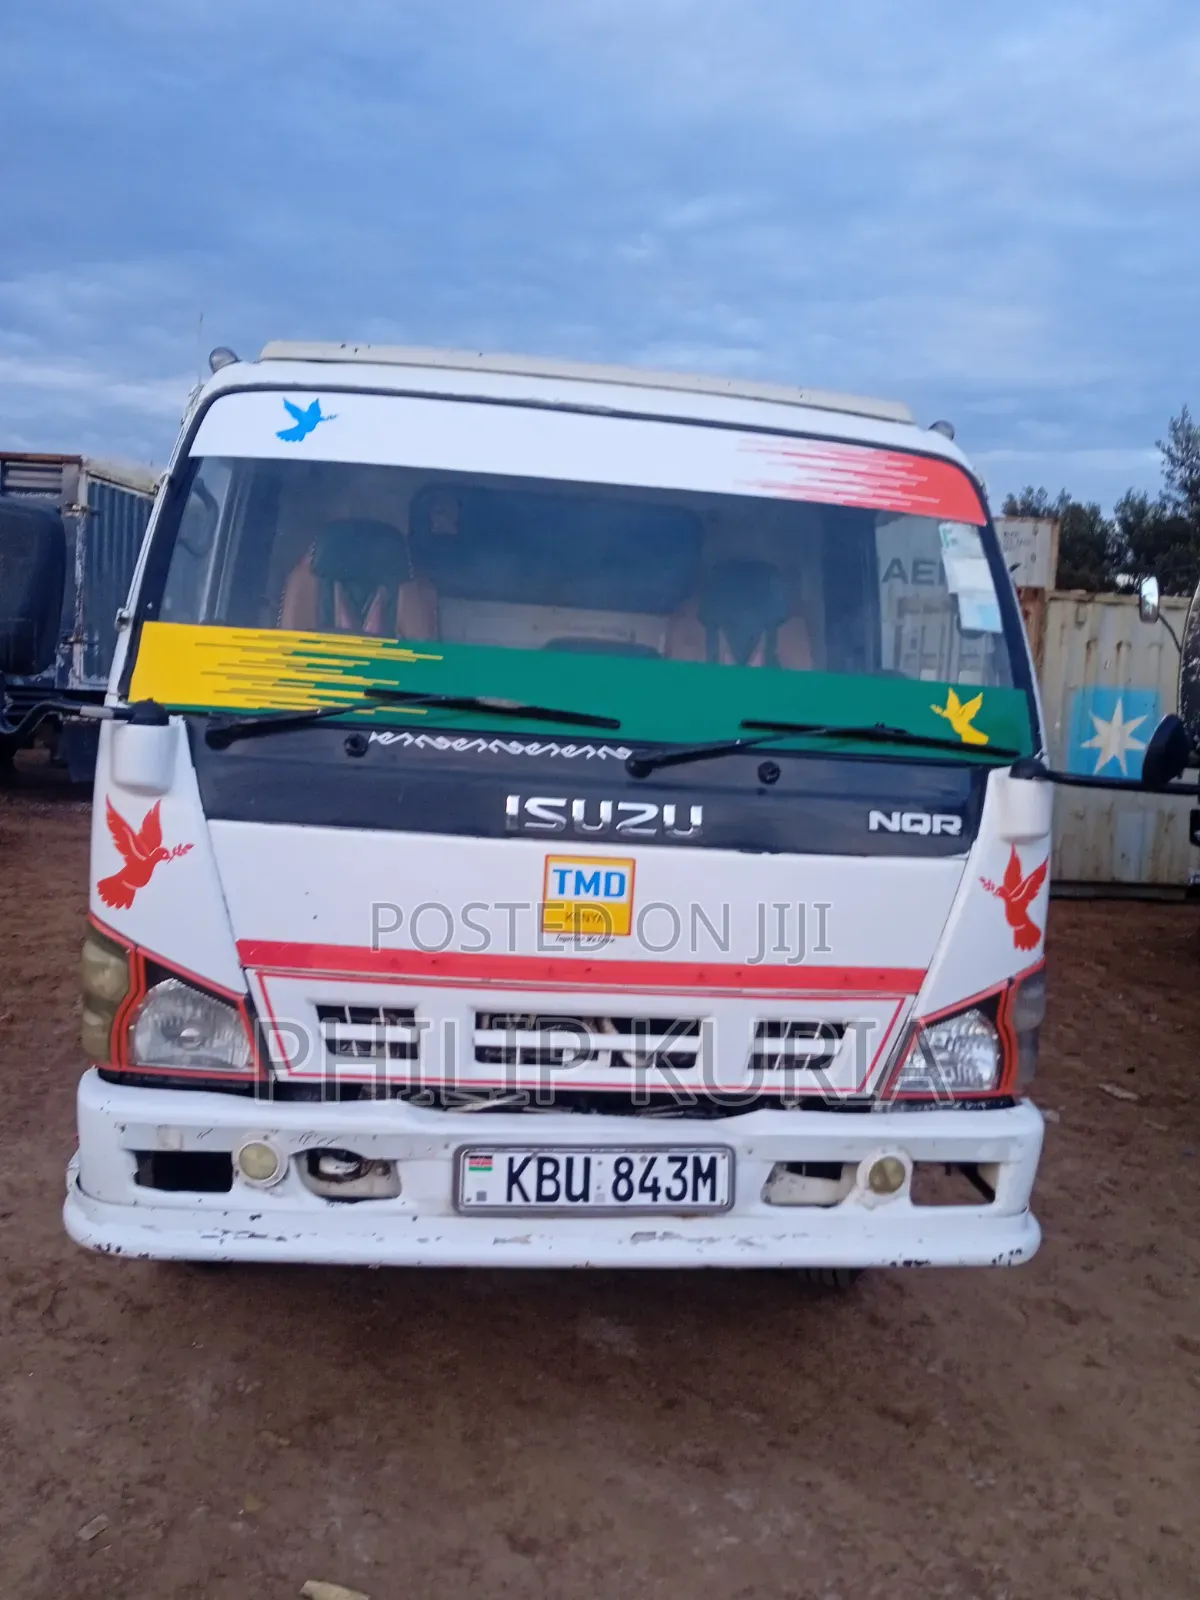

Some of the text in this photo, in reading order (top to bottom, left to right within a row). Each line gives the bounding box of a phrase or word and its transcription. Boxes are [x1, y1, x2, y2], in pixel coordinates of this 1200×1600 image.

[881, 558, 946, 585] AE
[505, 795, 703, 838] ISUZU
[868, 809, 962, 835] NQR
[553, 869, 625, 897] TMD
[506, 1156, 717, 1203] KBU 843M
